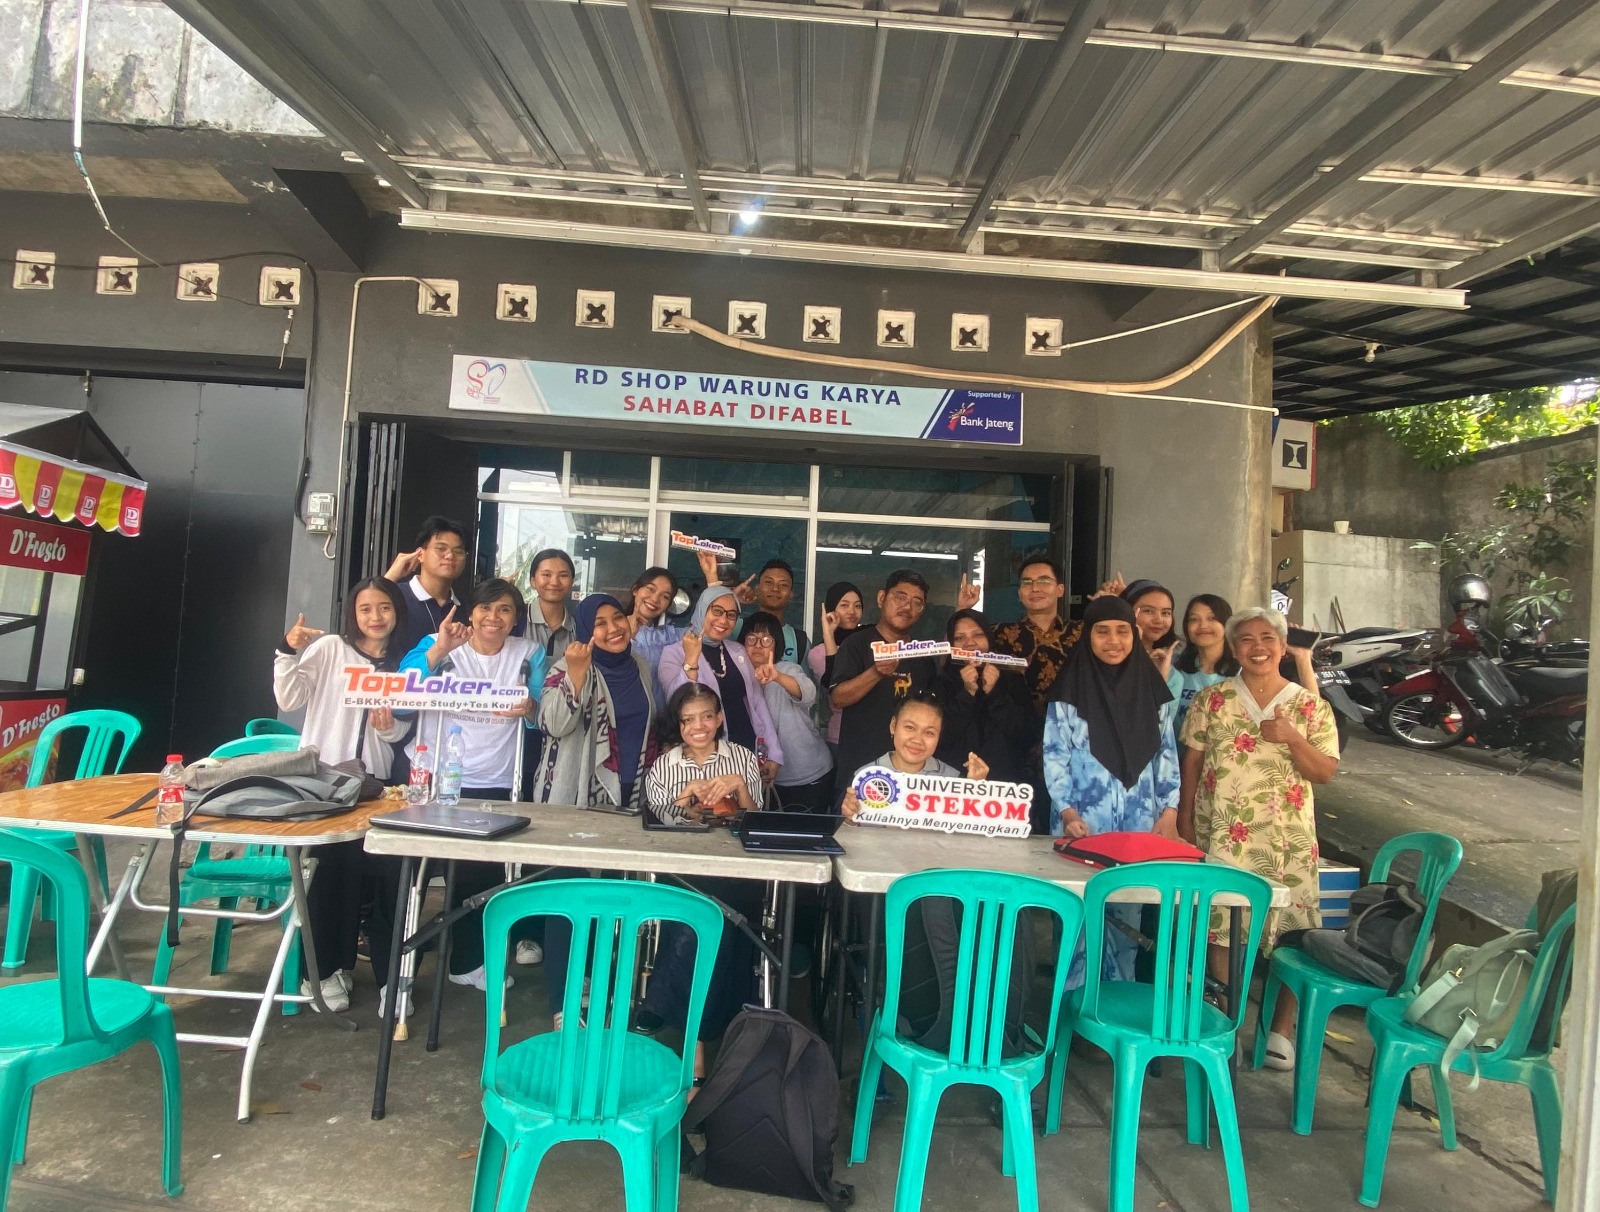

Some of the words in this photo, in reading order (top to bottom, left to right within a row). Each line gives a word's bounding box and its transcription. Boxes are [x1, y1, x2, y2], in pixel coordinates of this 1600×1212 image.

[575, 368, 609, 385] RD
[621, 371, 687, 390] SHOP
[699, 376, 809, 400] WARUNG
[821, 385, 902, 406] KARYA
[967, 390, 1002, 399] Supported
[623, 395, 738, 417] SAHABAT
[750, 404, 853, 426] DIFABEL
[960, 415, 983, 427] Bank
[984, 417, 1014, 431] Jateng
[9, 528, 66, 562] D'Fresto
[344, 667, 525, 697] TopLoker.com
[344, 697, 428, 708] E-BKK+Tracer
[430, 700, 488, 711] Study+Tes
[2, 704, 60, 748] D'Fresto
[906, 778, 1030, 800] UNIVERSITAS
[905, 793, 1028, 821] STEKOM
[856, 811, 919, 826] Kuliahnya
[922, 818, 1019, 834] Menyenangkan
